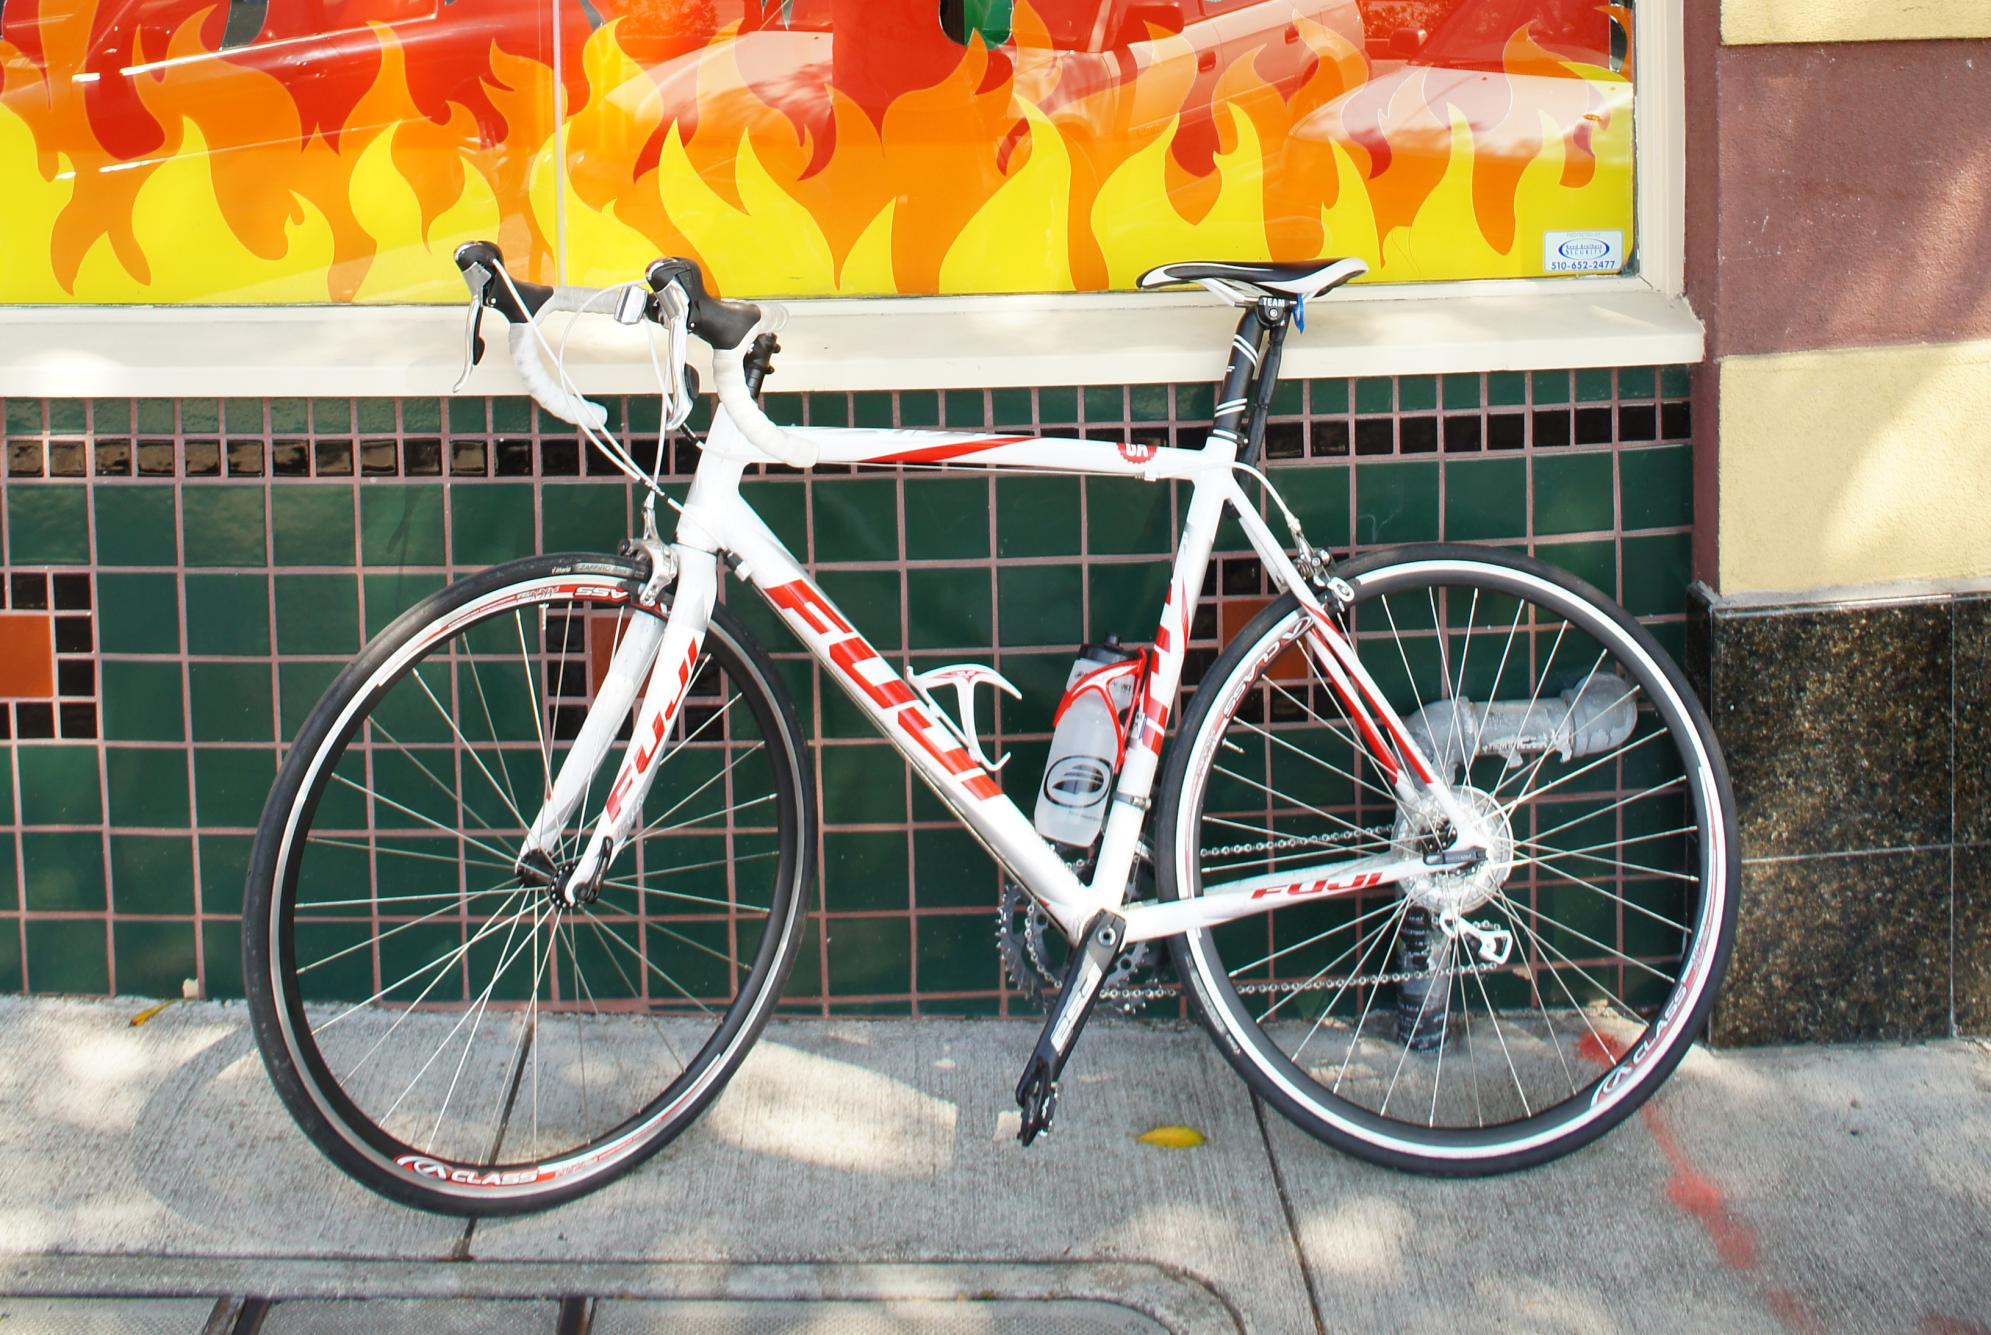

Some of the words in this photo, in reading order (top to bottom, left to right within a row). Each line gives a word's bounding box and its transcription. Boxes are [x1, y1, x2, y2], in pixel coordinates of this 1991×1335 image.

[1551, 260, 1616, 270] 510-652-2477
[1263, 297, 1285, 307] TEAM
[763, 578, 1003, 802] FUJI
[606, 636, 699, 825] FUJI
[1251, 871, 1383, 900] FUJI
[450, 1168, 540, 1187] CLASS
